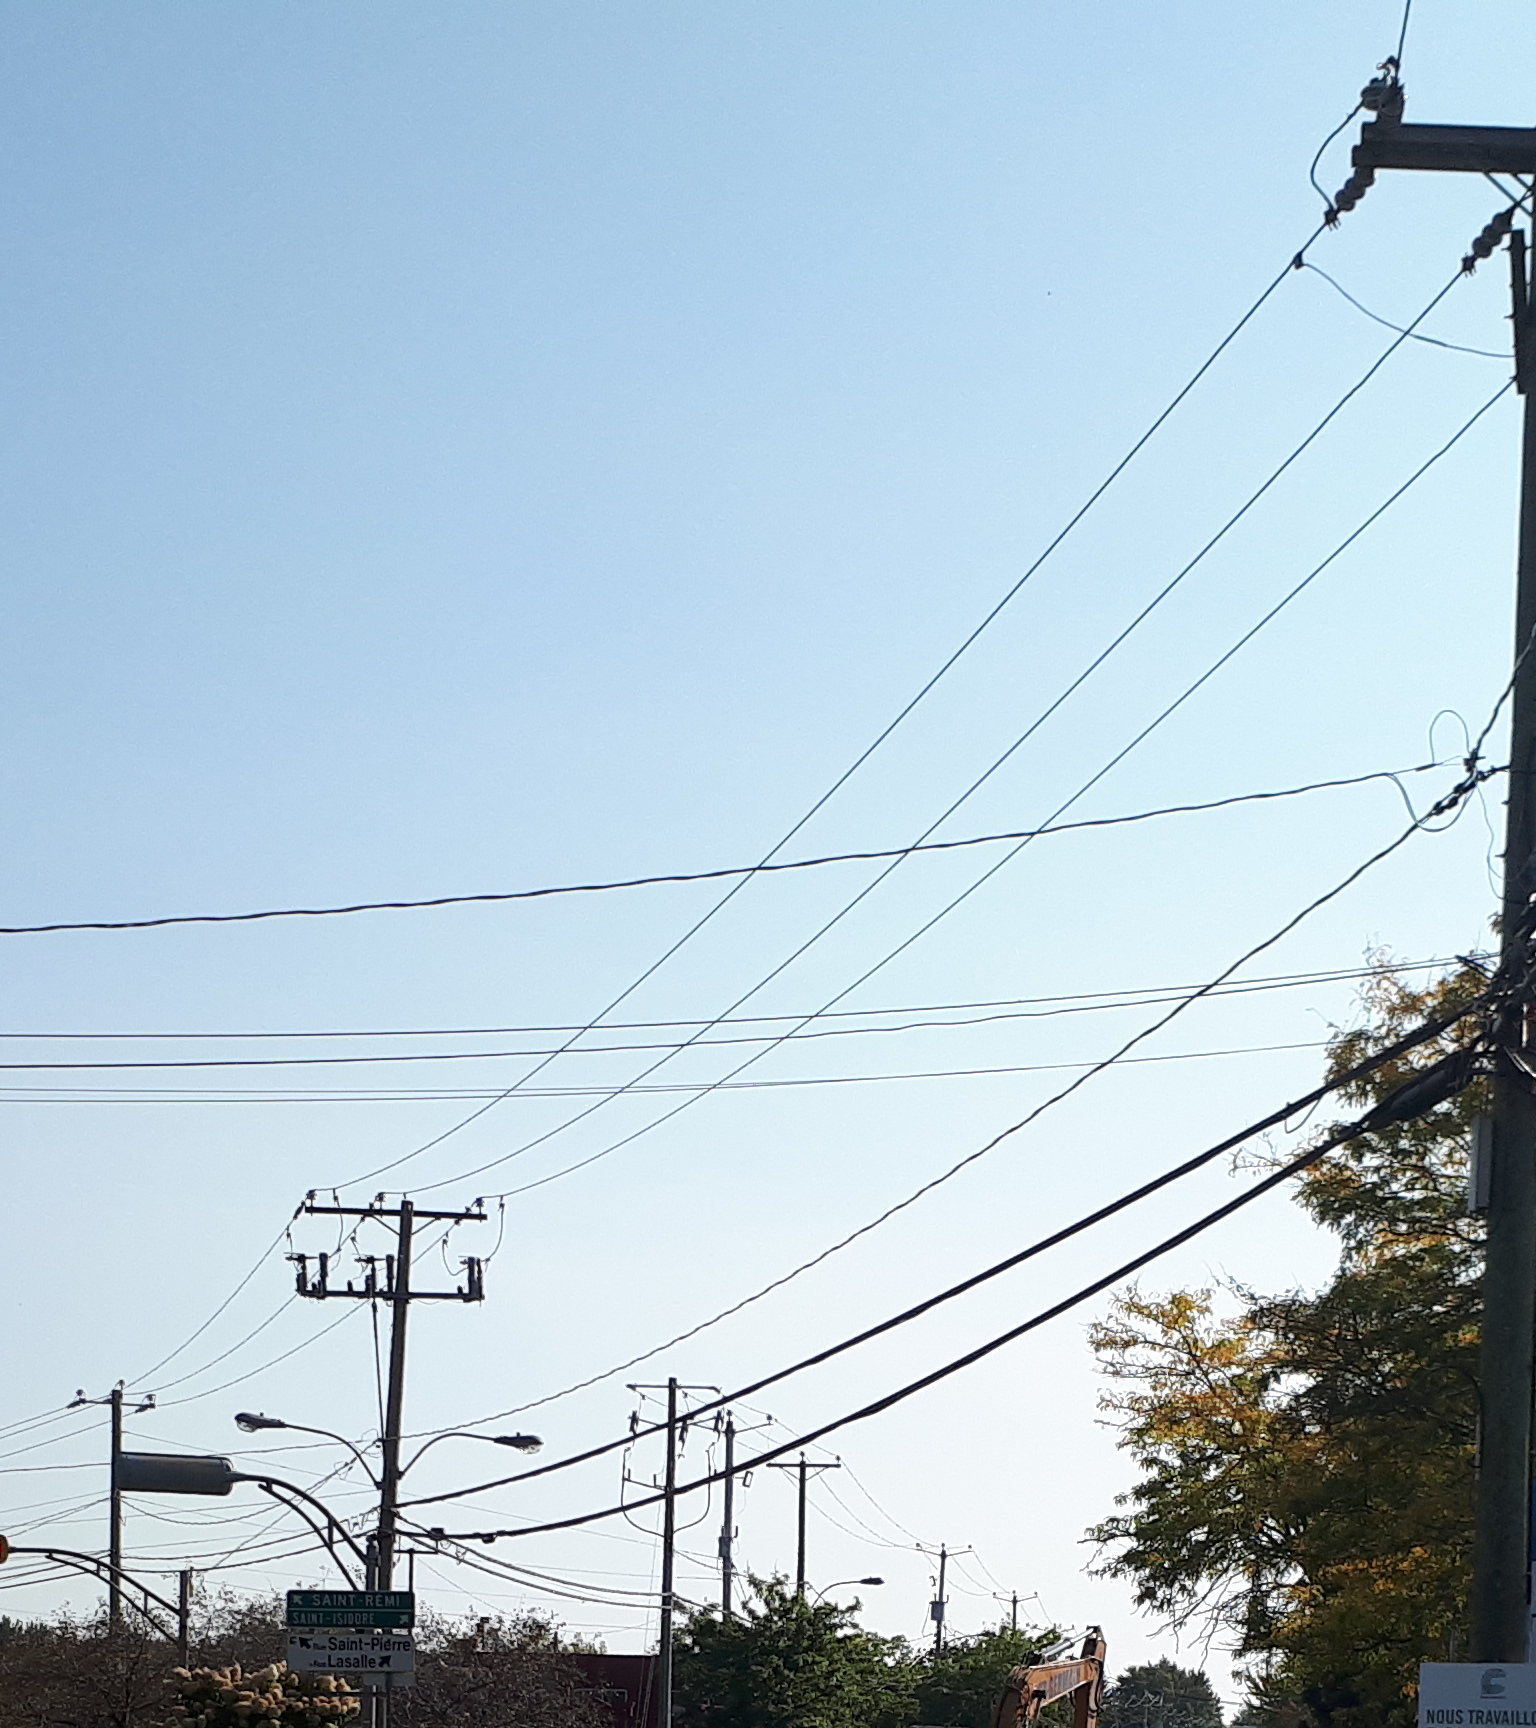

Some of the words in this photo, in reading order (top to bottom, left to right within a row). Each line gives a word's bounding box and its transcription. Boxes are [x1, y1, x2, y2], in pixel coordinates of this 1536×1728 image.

[292, 1612, 375, 1625] SAINT-ISIDORE
[327, 1636, 411, 1652] Saint-Pierre
[327, 1654, 377, 1669] Lasalle
[1426, 1709, 1463, 1724] NOUS
